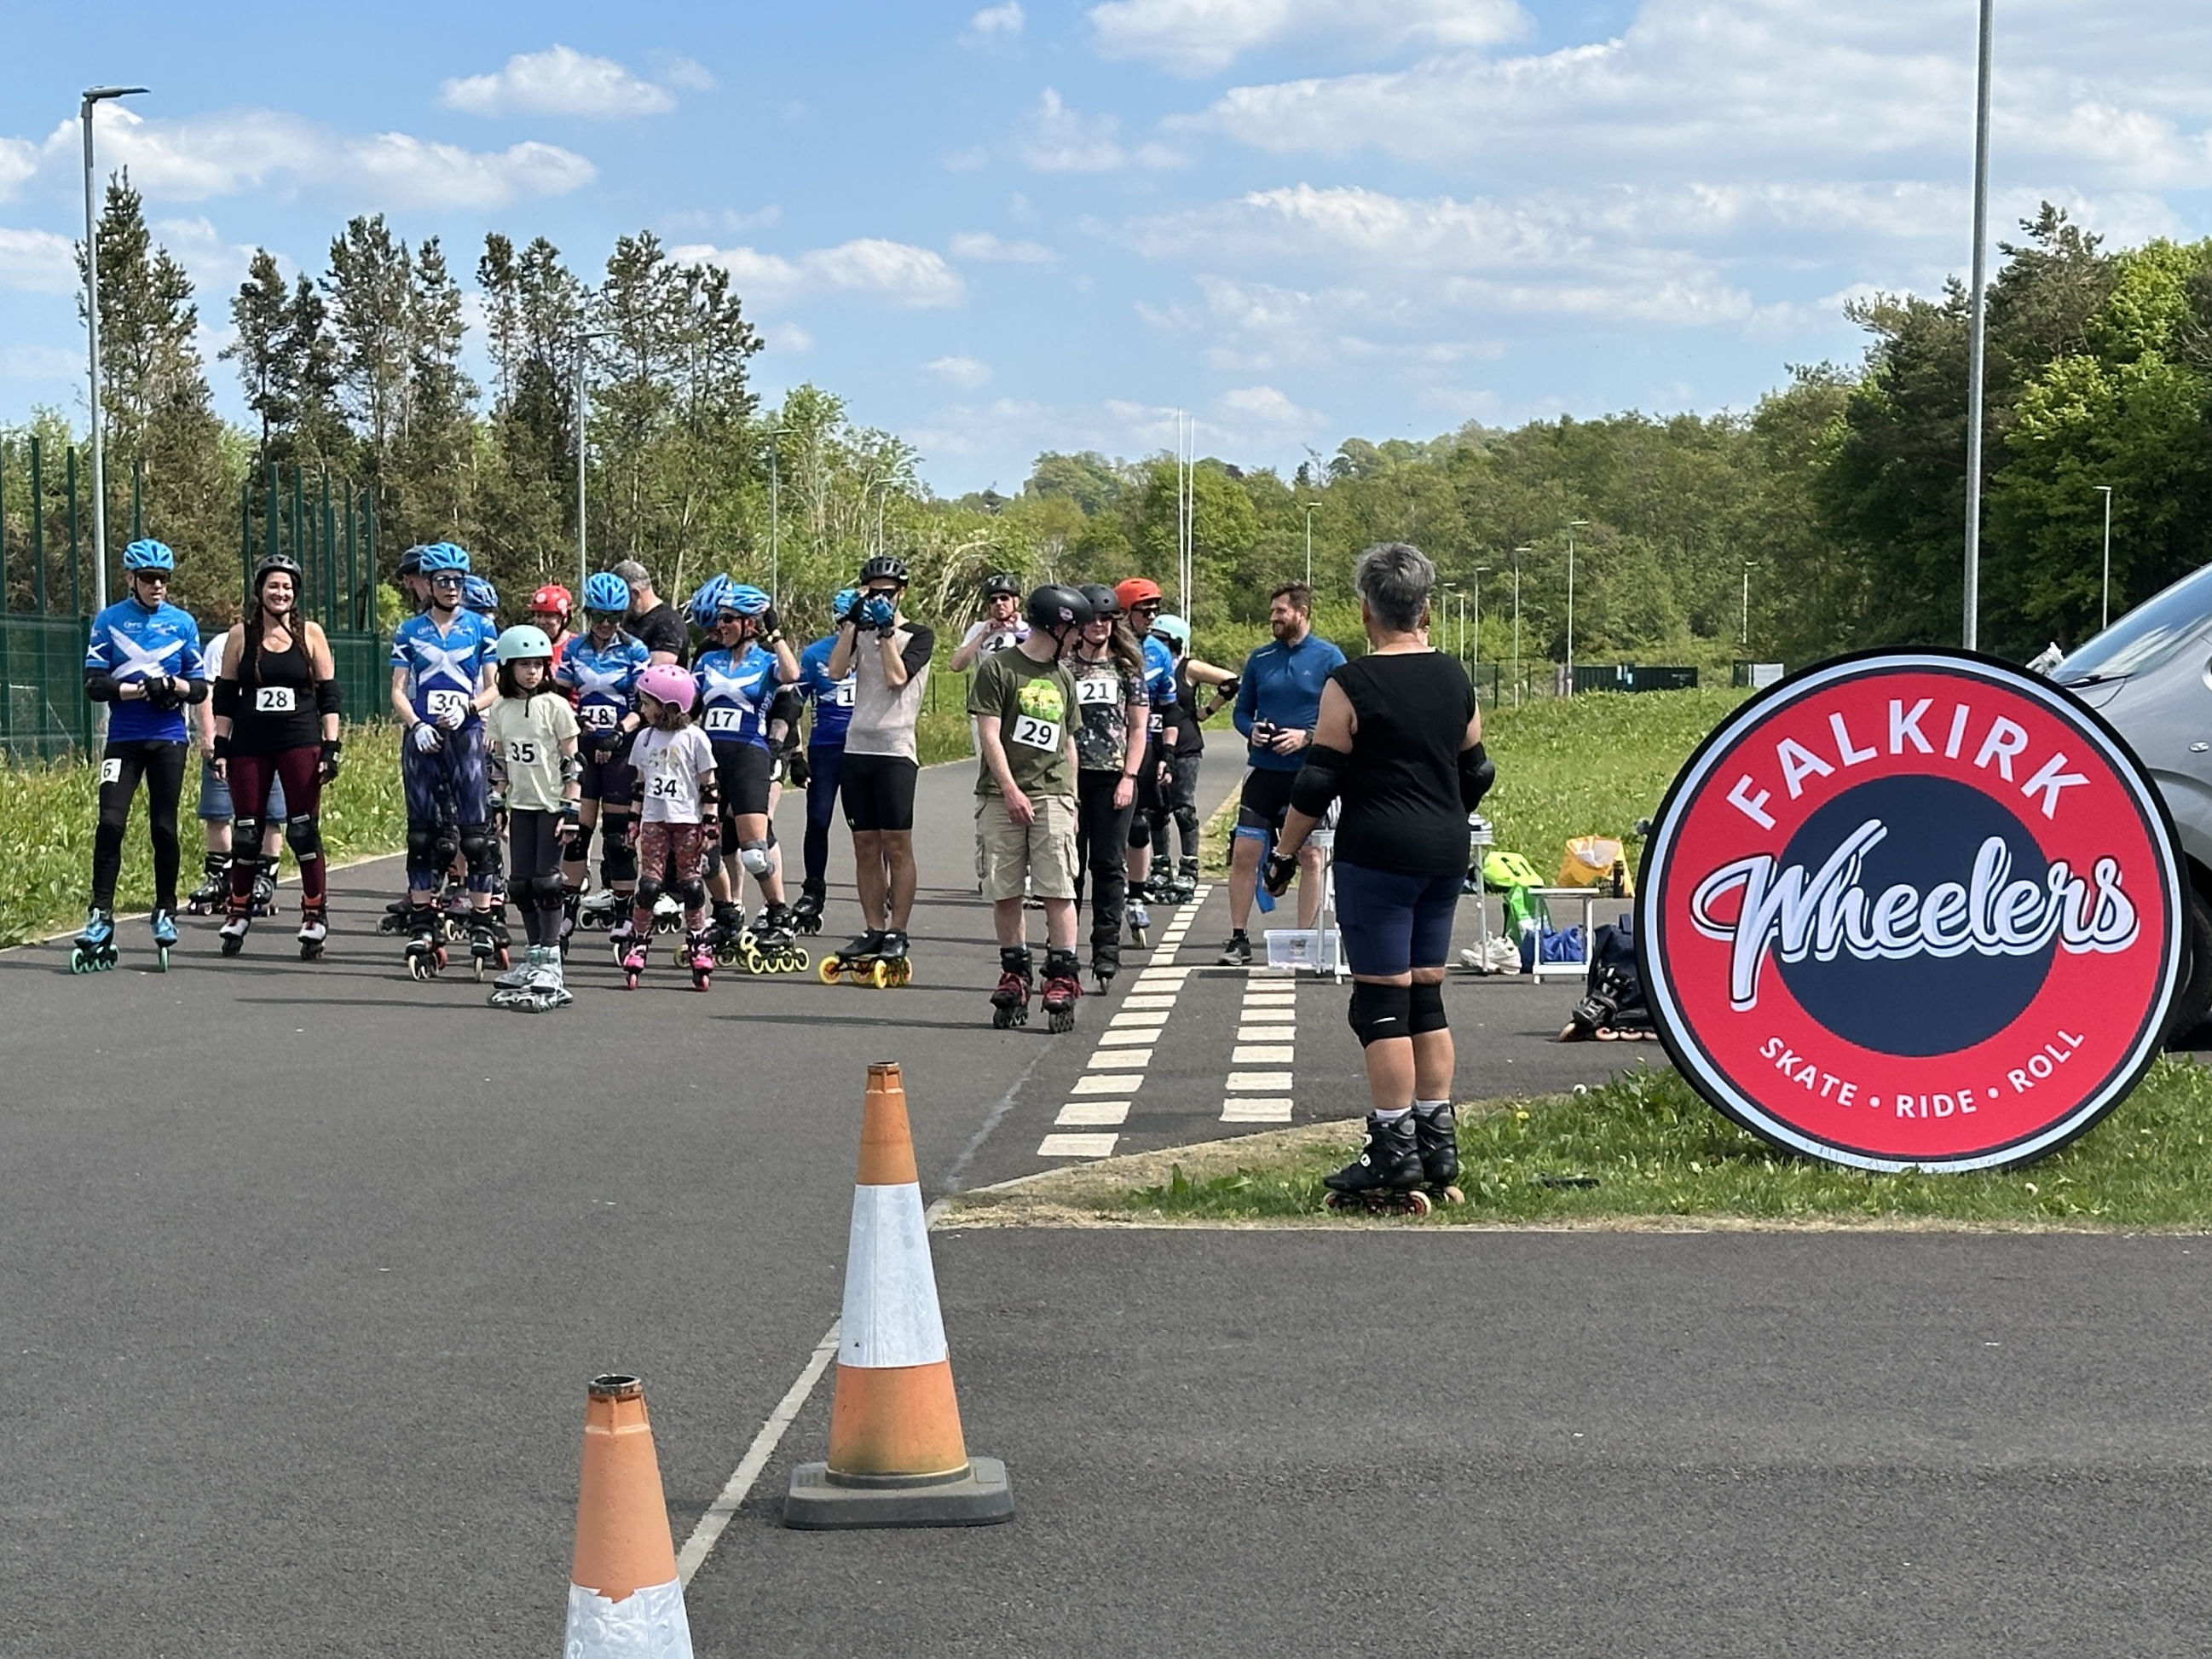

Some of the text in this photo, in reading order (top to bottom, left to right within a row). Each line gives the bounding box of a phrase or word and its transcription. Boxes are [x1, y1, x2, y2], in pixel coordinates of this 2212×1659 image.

[263, 691, 287, 708] 28
[1083, 683, 1110, 700] 21
[588, 708, 609, 725] 18
[710, 711, 735, 727] 17
[1021, 721, 1052, 745] 29
[511, 742, 534, 763] 35
[1726, 697, 2091, 830] FALKIRK
[654, 777, 677, 797] 34
[1690, 818, 2140, 1012] Wheelers
[1759, 1027, 2084, 1119] SKATE RIDE ROLL
